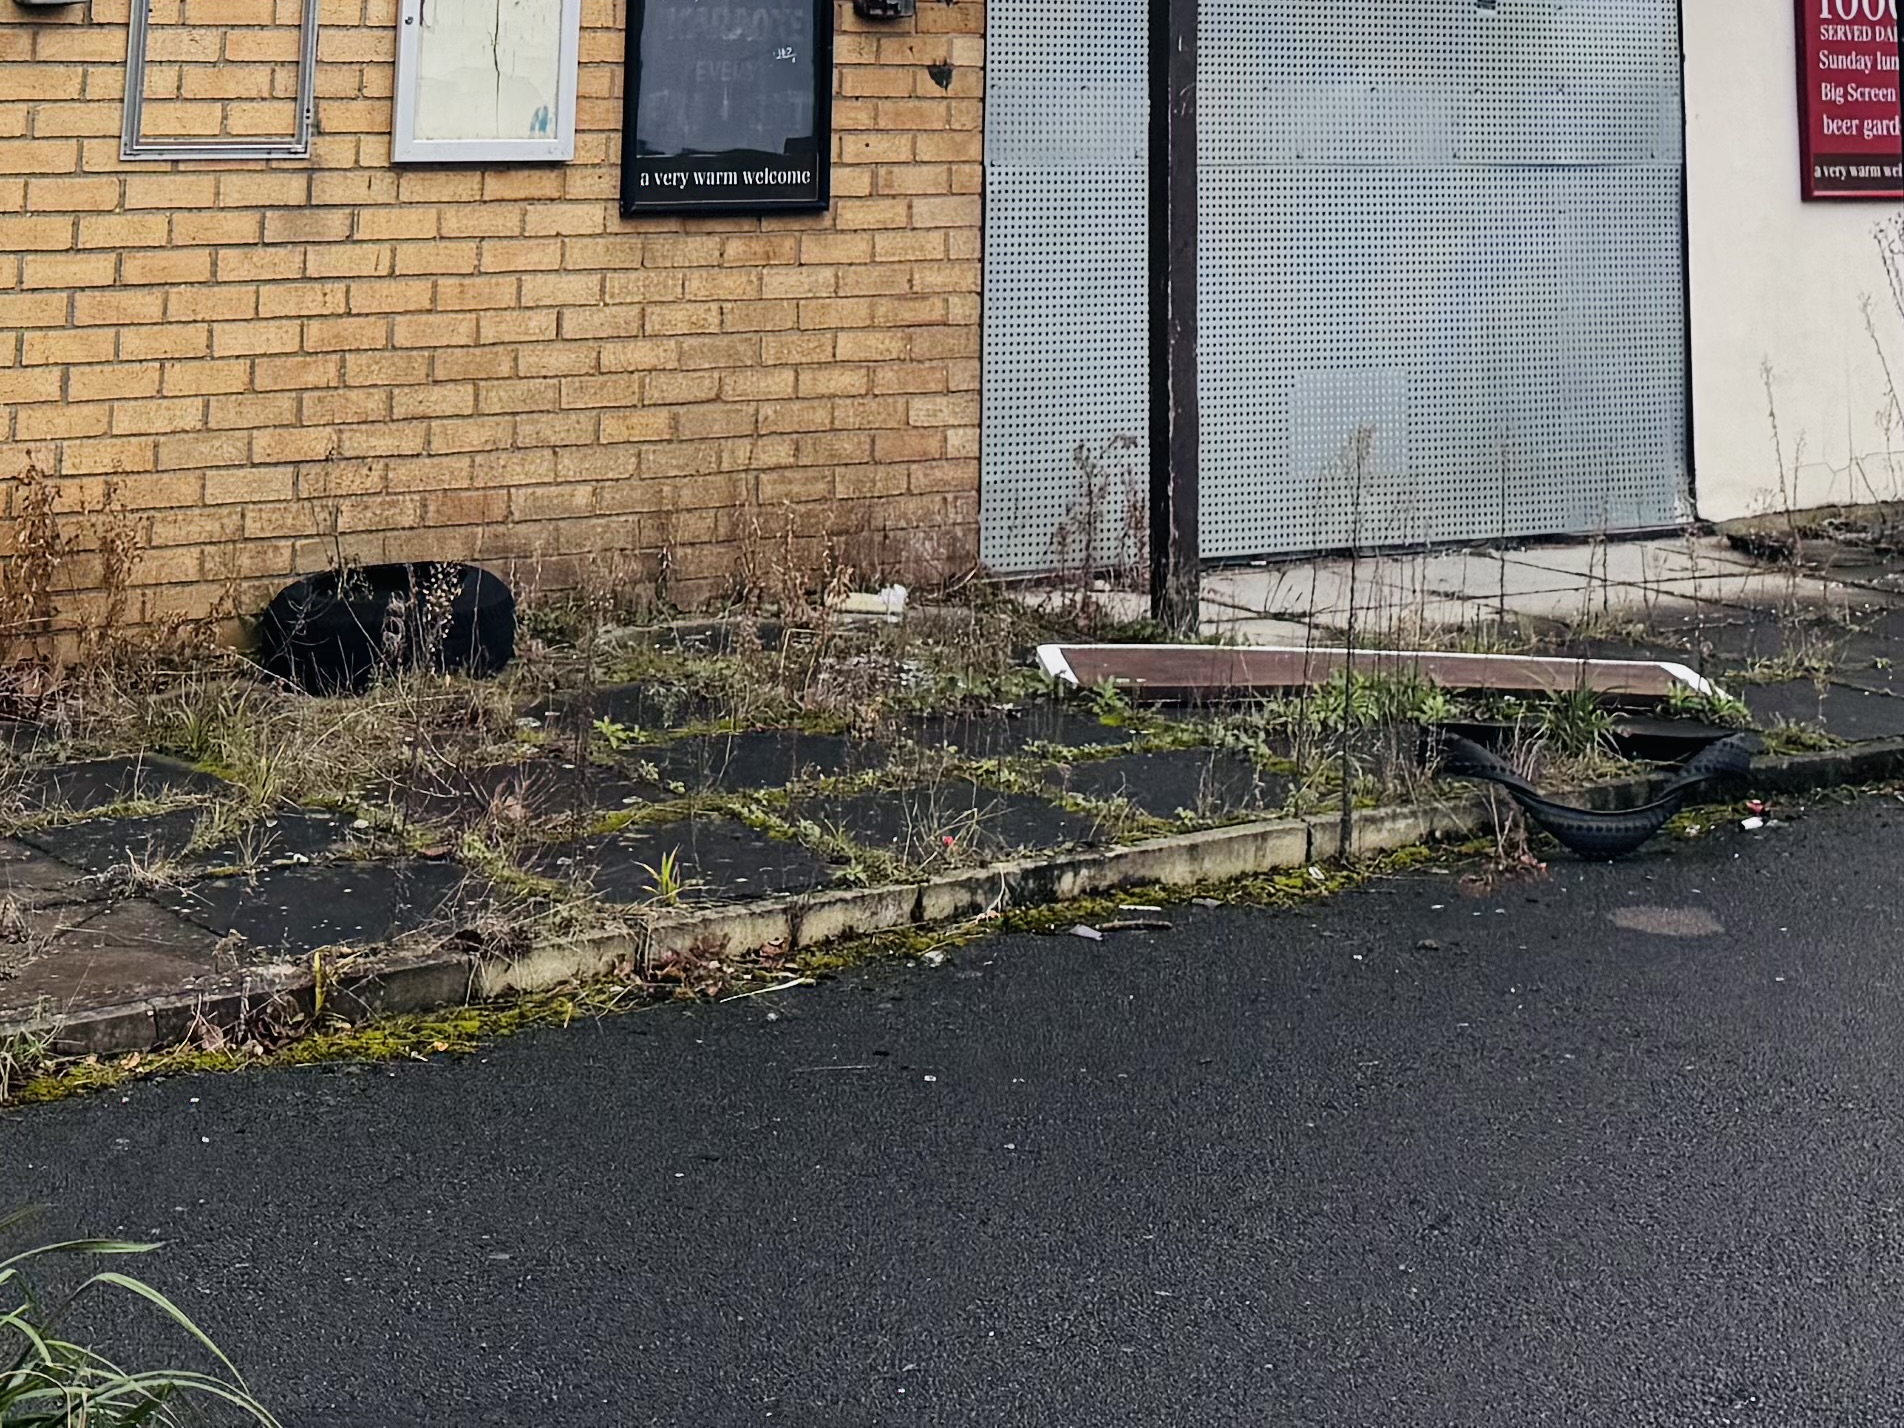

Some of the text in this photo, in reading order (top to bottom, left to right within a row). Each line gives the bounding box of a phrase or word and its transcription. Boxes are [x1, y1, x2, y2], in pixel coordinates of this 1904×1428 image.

[1820, 24, 1872, 42] SERVED
[1819, 50, 1900, 74] Sunday lun
[1821, 82, 1896, 105] Big Screen
[1823, 114, 1902, 140] beer gard
[640, 167, 811, 190] a very warm welcome
[1814, 163, 1902, 181] a very warm wel
